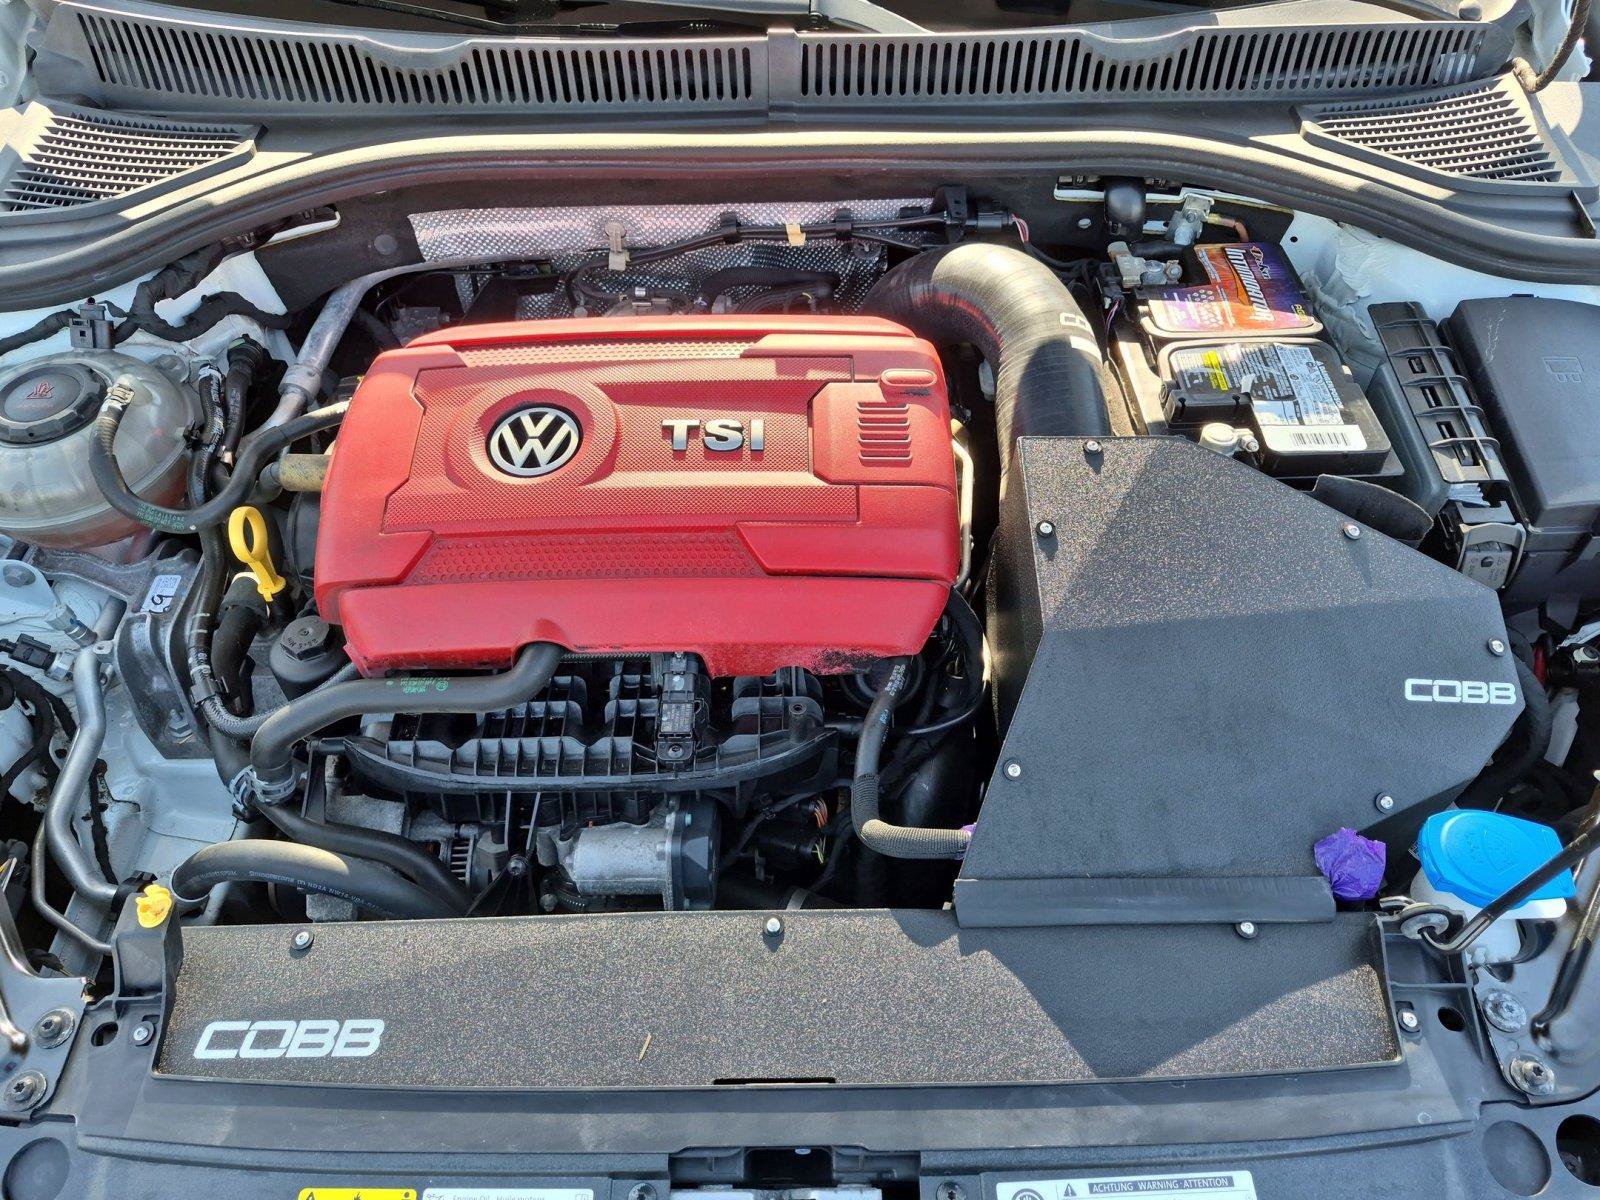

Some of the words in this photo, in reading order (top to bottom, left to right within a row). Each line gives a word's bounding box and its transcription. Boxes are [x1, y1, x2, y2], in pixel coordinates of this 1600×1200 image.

[662, 419, 764, 451] TSI
[1405, 678, 1517, 705] COBB
[193, 1019, 385, 1059] COBB
[1092, 1182, 1134, 1193] ACHTUNG
[1138, 1180, 1179, 1191] WARNING
[1183, 1177, 1229, 1188] ATTENTION
